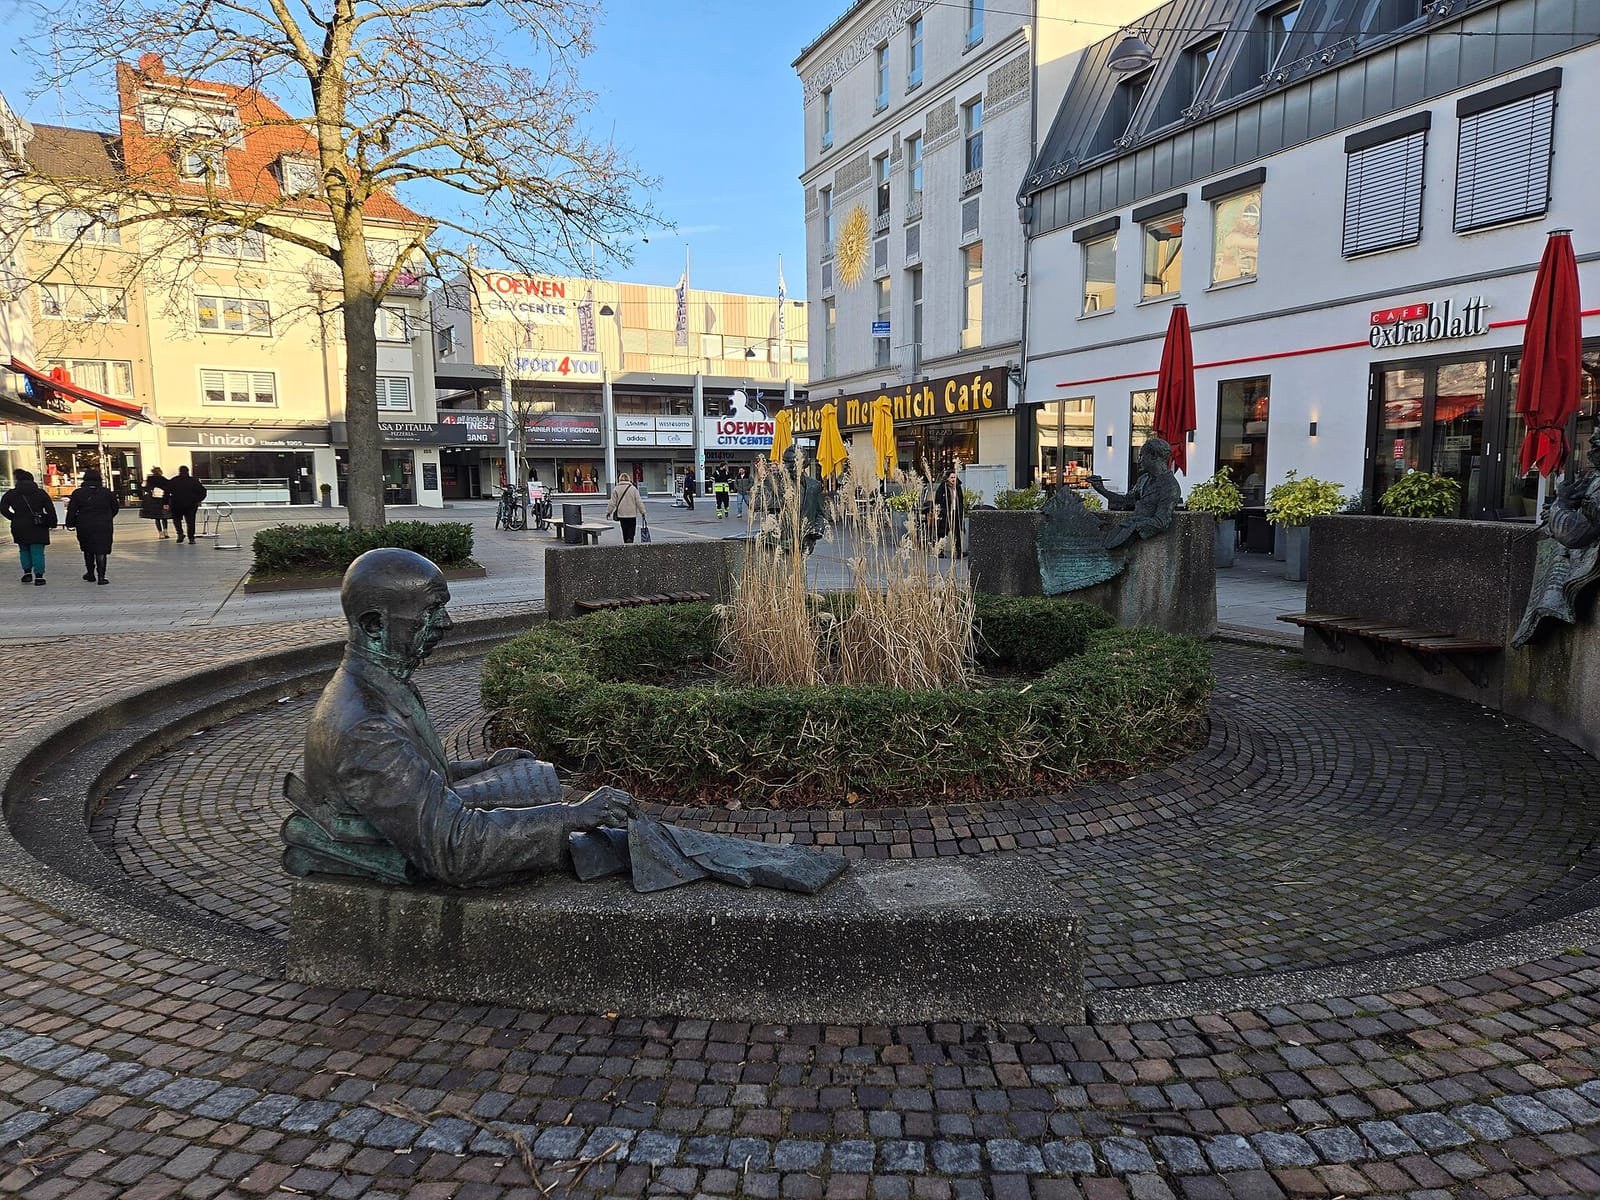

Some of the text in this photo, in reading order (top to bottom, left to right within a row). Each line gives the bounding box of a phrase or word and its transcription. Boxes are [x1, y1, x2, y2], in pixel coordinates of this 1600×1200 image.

[486, 274, 565, 298] LOEWEN
[1369, 296, 1488, 348] extrablatt
[1372, 306, 1424, 323] CAFE
[846, 385, 935, 426] mernich
[944, 375, 993, 413] Cafe
[395, 423, 433, 432] D'ITALIA
[717, 421, 774, 435] LOEWEN
[626, 434, 647, 442] adidas
